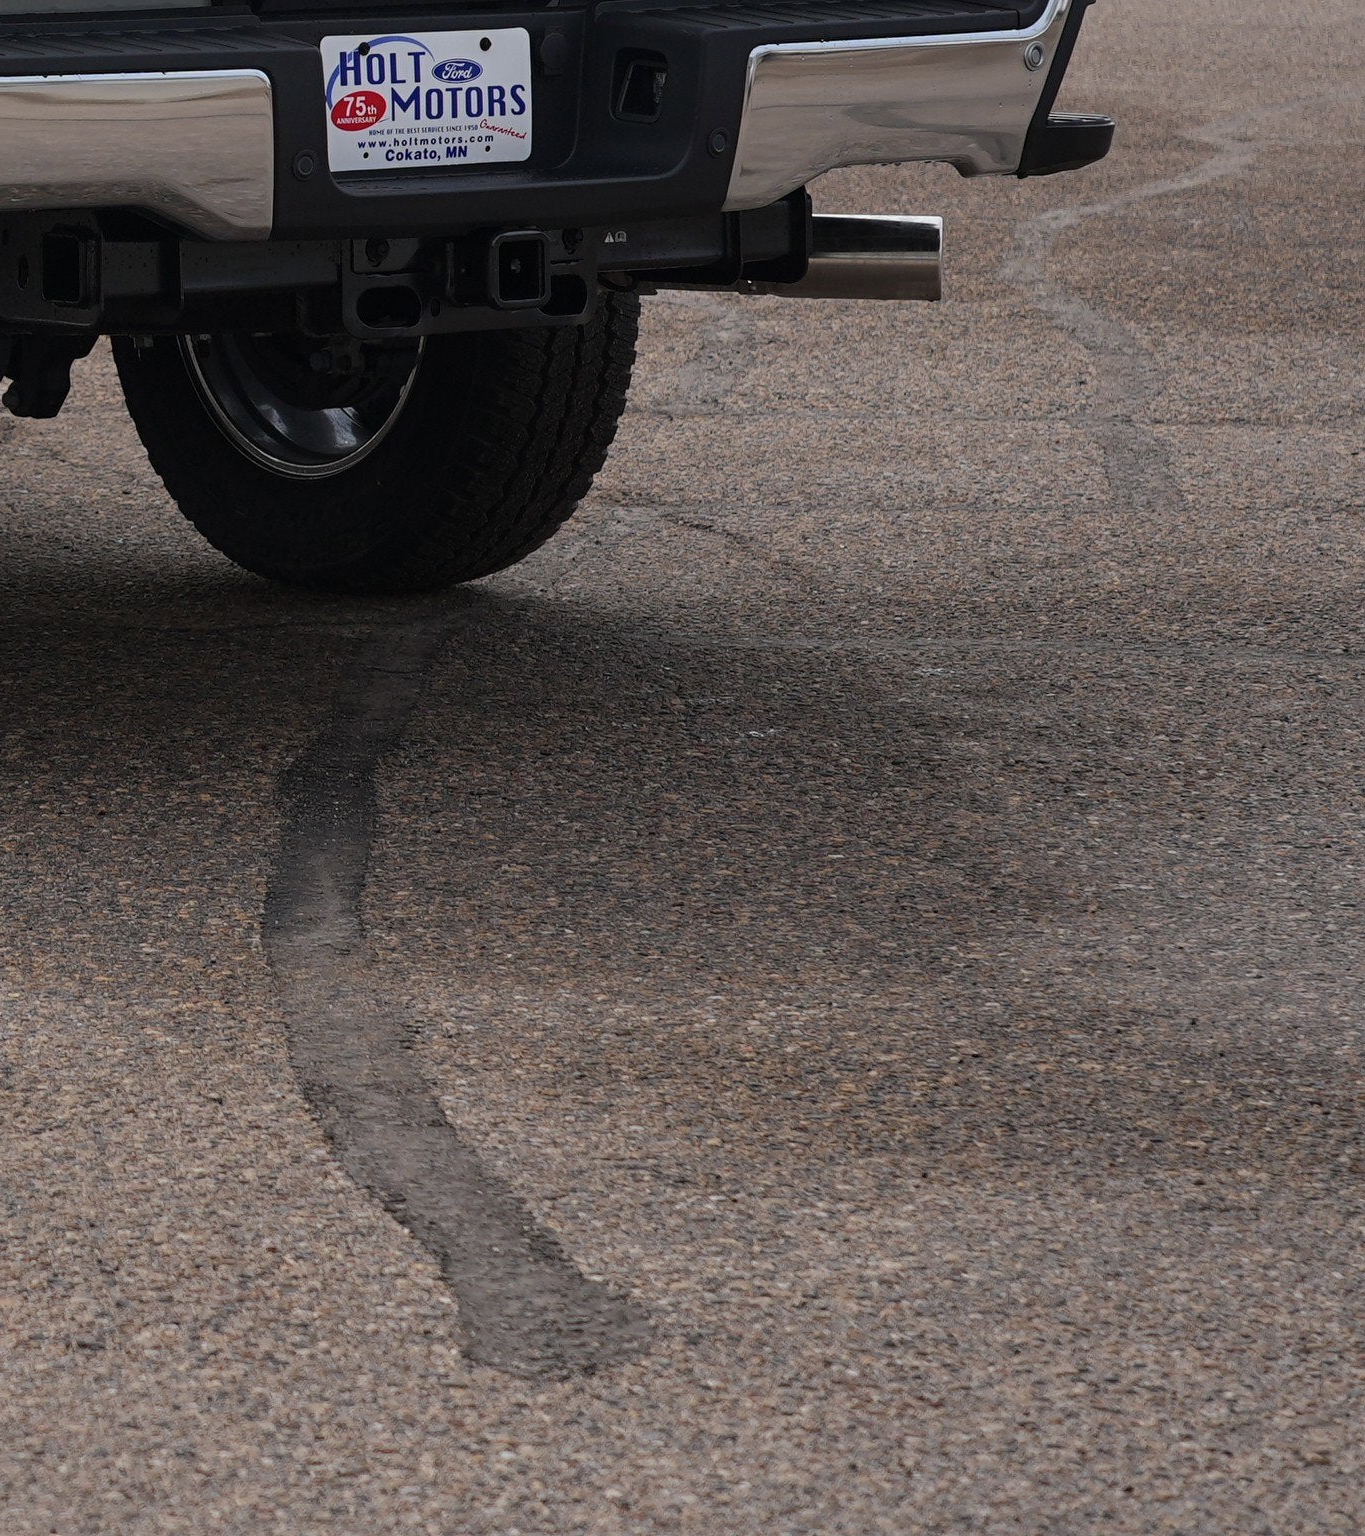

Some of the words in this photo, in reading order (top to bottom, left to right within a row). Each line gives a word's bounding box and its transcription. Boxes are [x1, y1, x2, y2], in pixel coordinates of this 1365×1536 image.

[339, 51, 426, 86] HOLT
[343, 96, 378, 117] 75th
[391, 84, 527, 122] MOTORS
[336, 115, 377, 126] ANNIVERSARY
[464, 124, 479, 132] 1950
[479, 118, 527, 140] Guaranteed
[357, 134, 495, 149] www.holtmotors.com
[385, 148, 441, 163] Cokato,
[446, 146, 468, 159] MN
